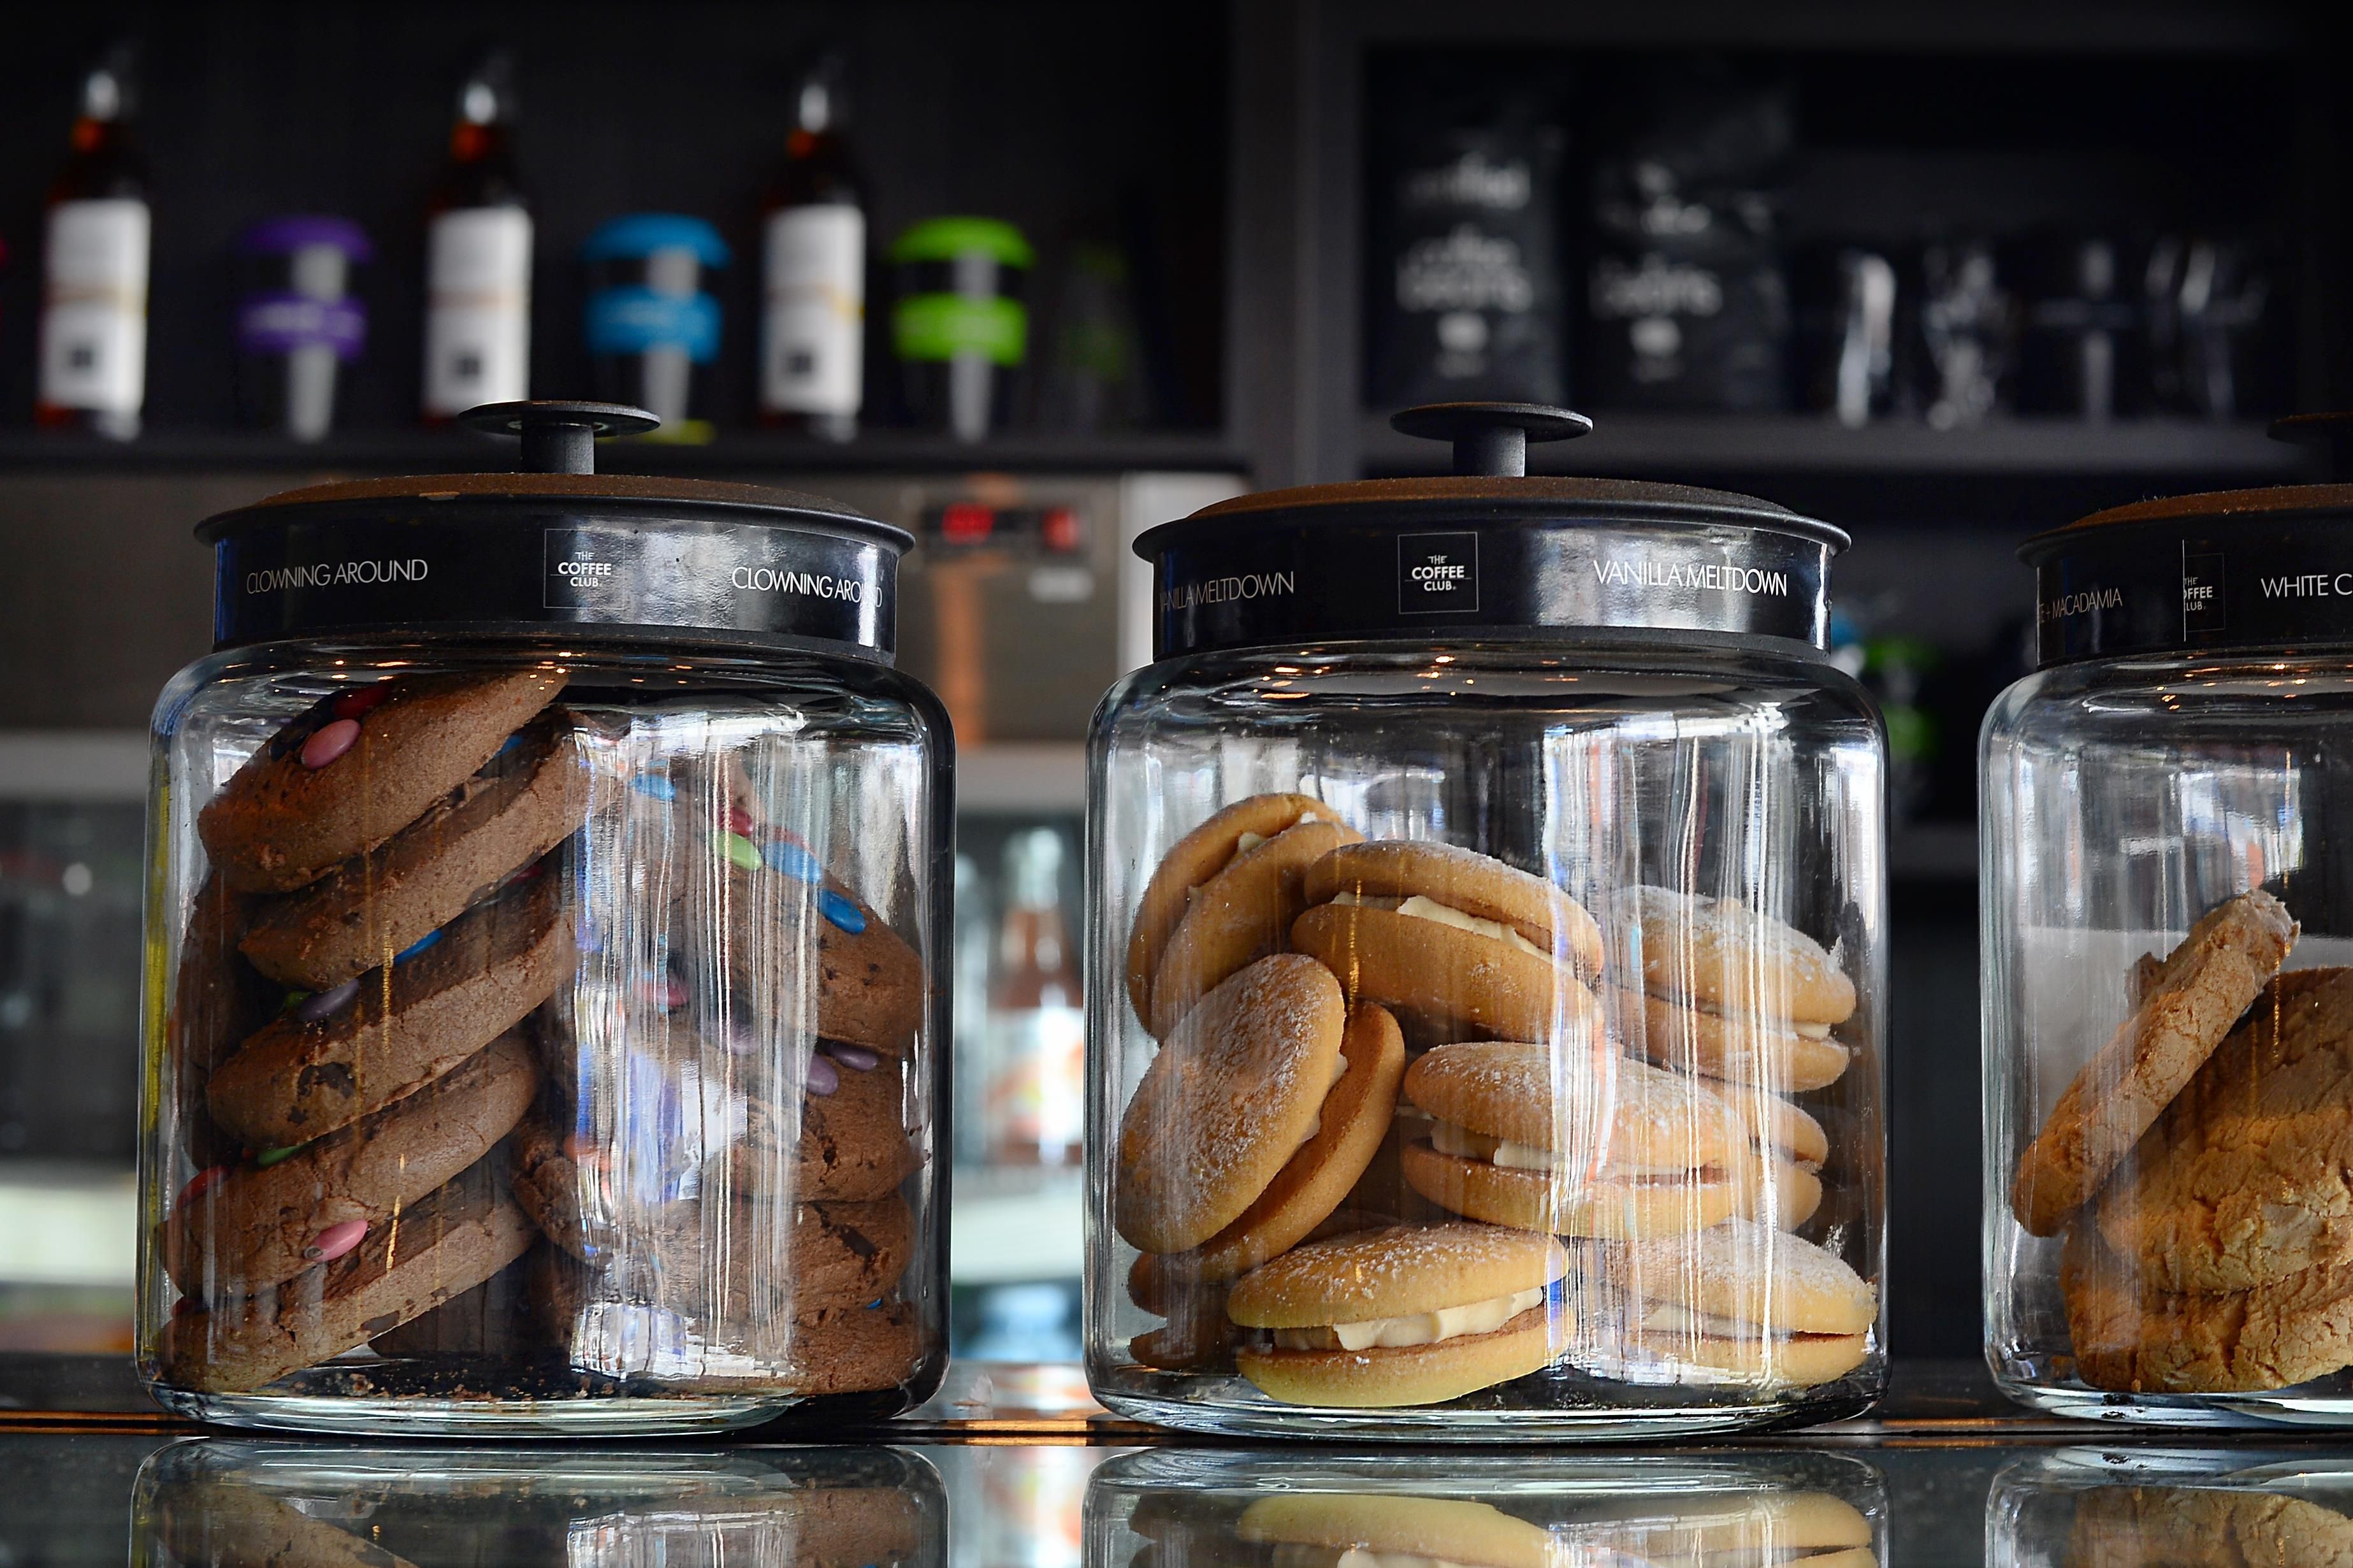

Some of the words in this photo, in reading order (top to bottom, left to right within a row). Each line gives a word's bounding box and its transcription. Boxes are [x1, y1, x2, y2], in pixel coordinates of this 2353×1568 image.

[558, 562, 612, 576] COFFEE
[574, 551, 595, 561] THE
[1428, 554, 1448, 565] THE
[247, 563, 331, 594] CLOWNING
[333, 559, 428, 585] AROUND
[732, 566, 833, 598] CLOWNING
[1411, 565, 1465, 580] COFFEE
[1593, 560, 1683, 587] VANILLA
[1686, 564, 1788, 597] MELTDOWN
[2261, 574, 2329, 599] WHITE
[1195, 571, 1294, 606] MELTDOWN
[2052, 587, 2124, 619] MACADAMIA
